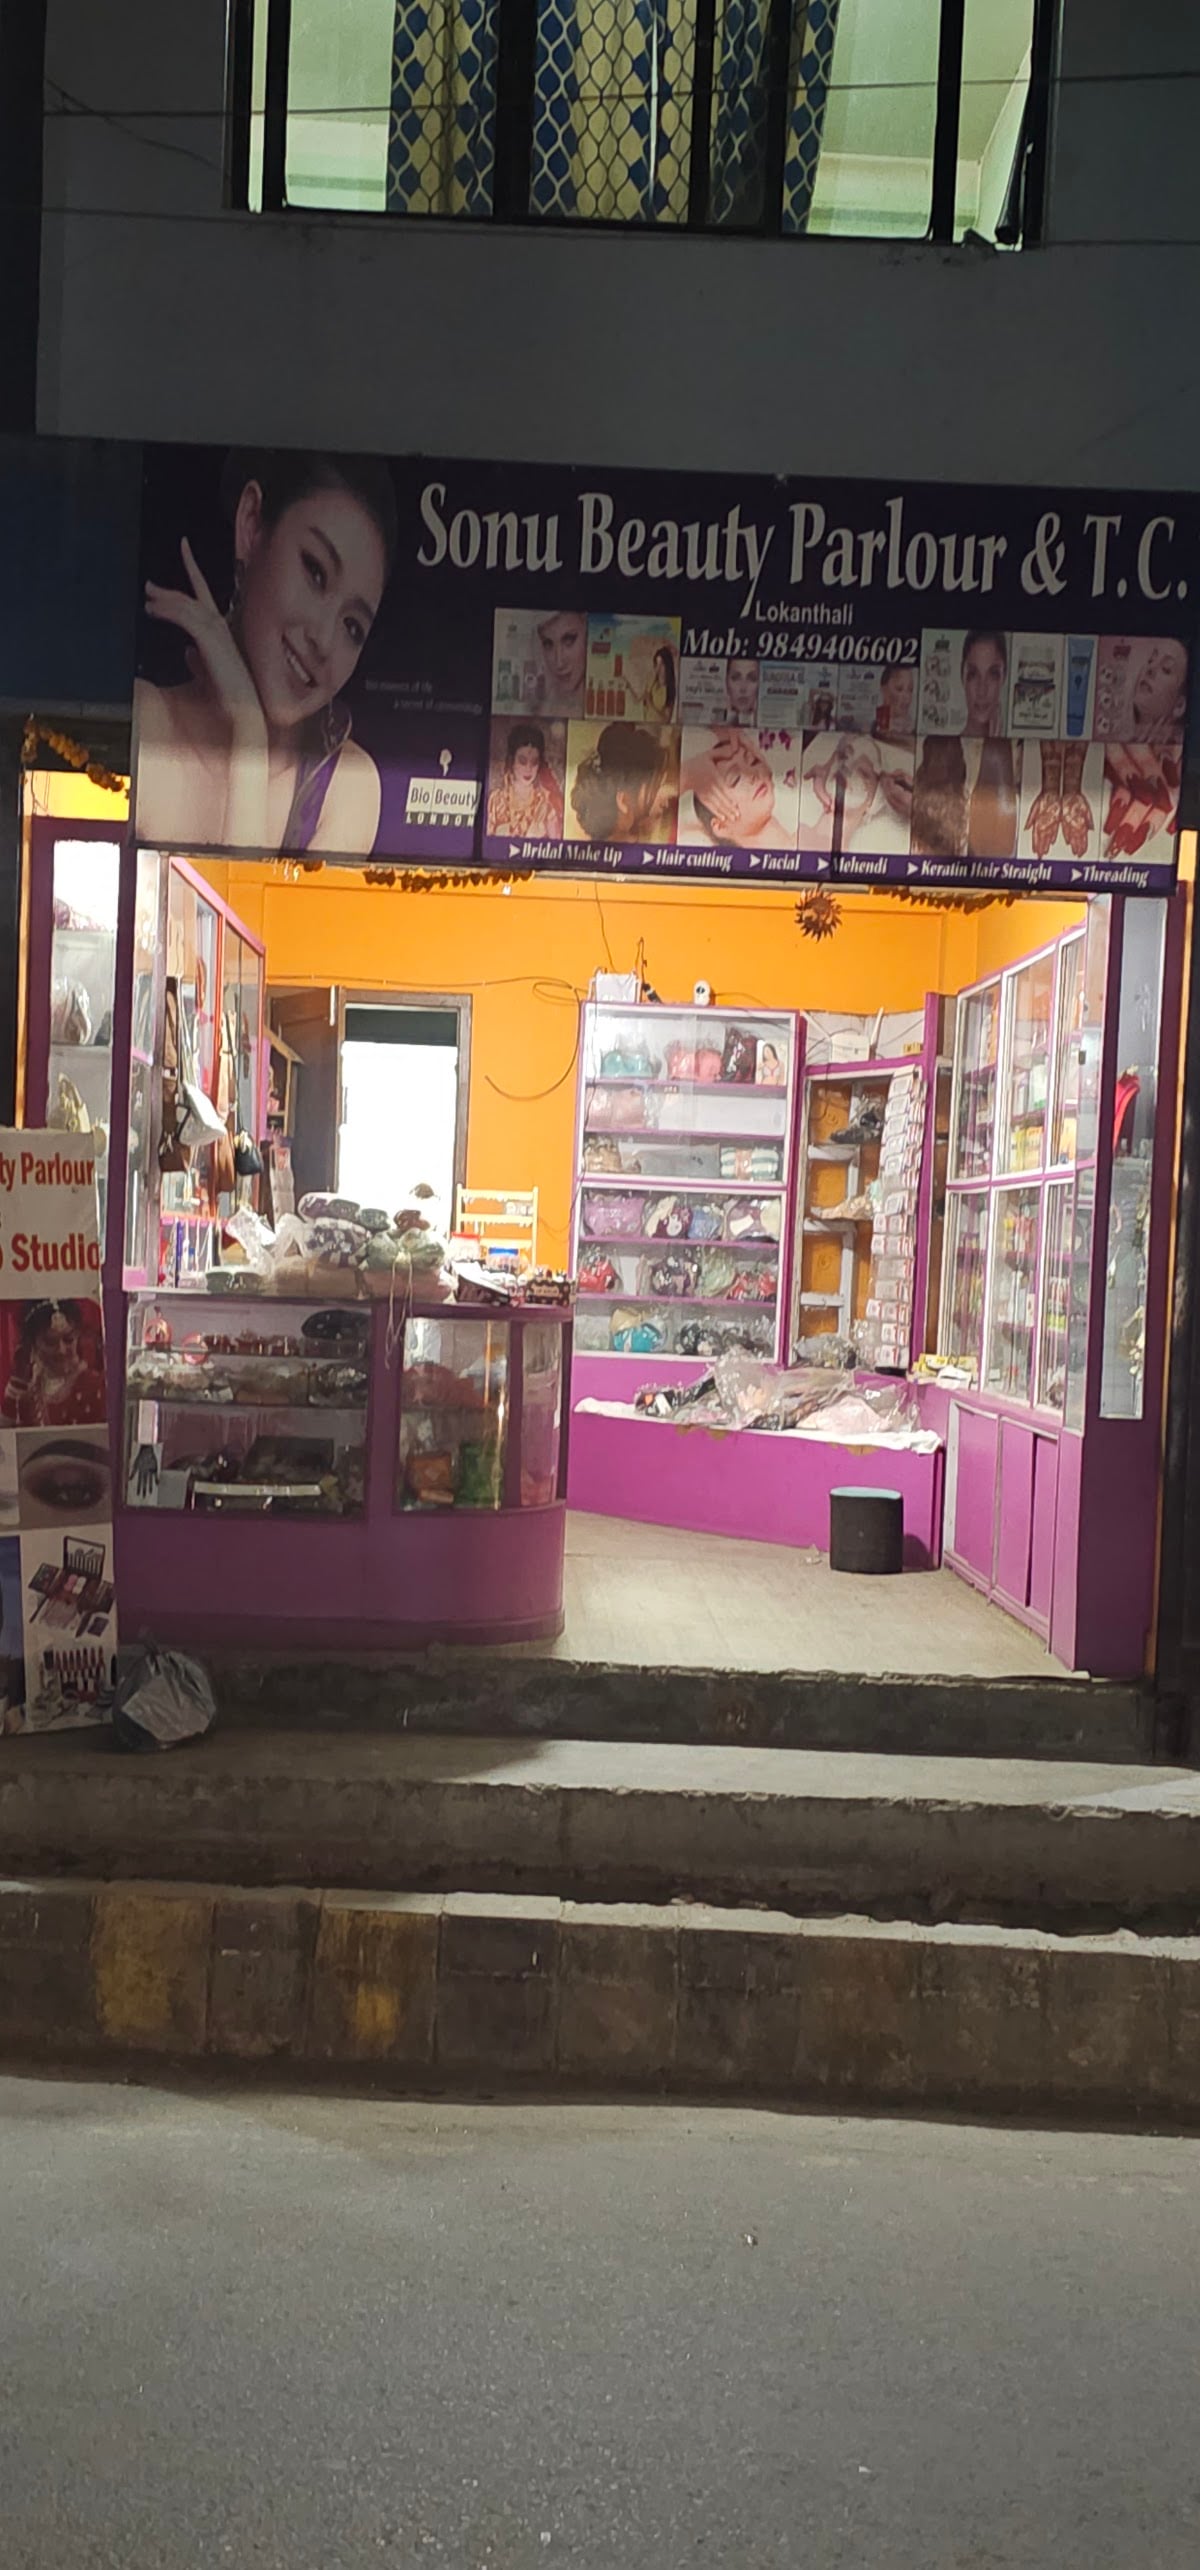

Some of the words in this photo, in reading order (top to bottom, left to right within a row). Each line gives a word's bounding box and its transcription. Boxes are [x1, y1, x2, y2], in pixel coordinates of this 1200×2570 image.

[417, 482, 563, 573] Sonu
[577, 492, 775, 618] Beauty
[789, 496, 1007, 593] Parlour
[1021, 511, 1067, 595] &
[1083, 514, 1188, 600] T.C.
[755, 600, 854, 626] Lokanthali
[683, 627, 749, 657] Mob:
[756, 631, 920, 664] 9849406602
[410, 787, 430, 804] Bio
[435, 788, 478, 811] Beauty
[406, 812, 475, 827] LONDON
[521, 842, 562, 861] Bridal
[565, 845, 600, 862] Make
[603, 848, 622, 867] Up
[656, 848, 685, 866] Hair
[686, 851, 733, 872] cutting
[762, 852, 800, 871] Facial
[833, 856, 888, 875] Mehendi
[920, 859, 968, 877] Keratin
[971, 861, 1000, 879] Hair
[1002, 862, 1052, 883] Straight
[1082, 865, 1149, 888] Threading
[21, 1152, 95, 1186] Parlour
[11, 1232, 100, 1273] Studio
